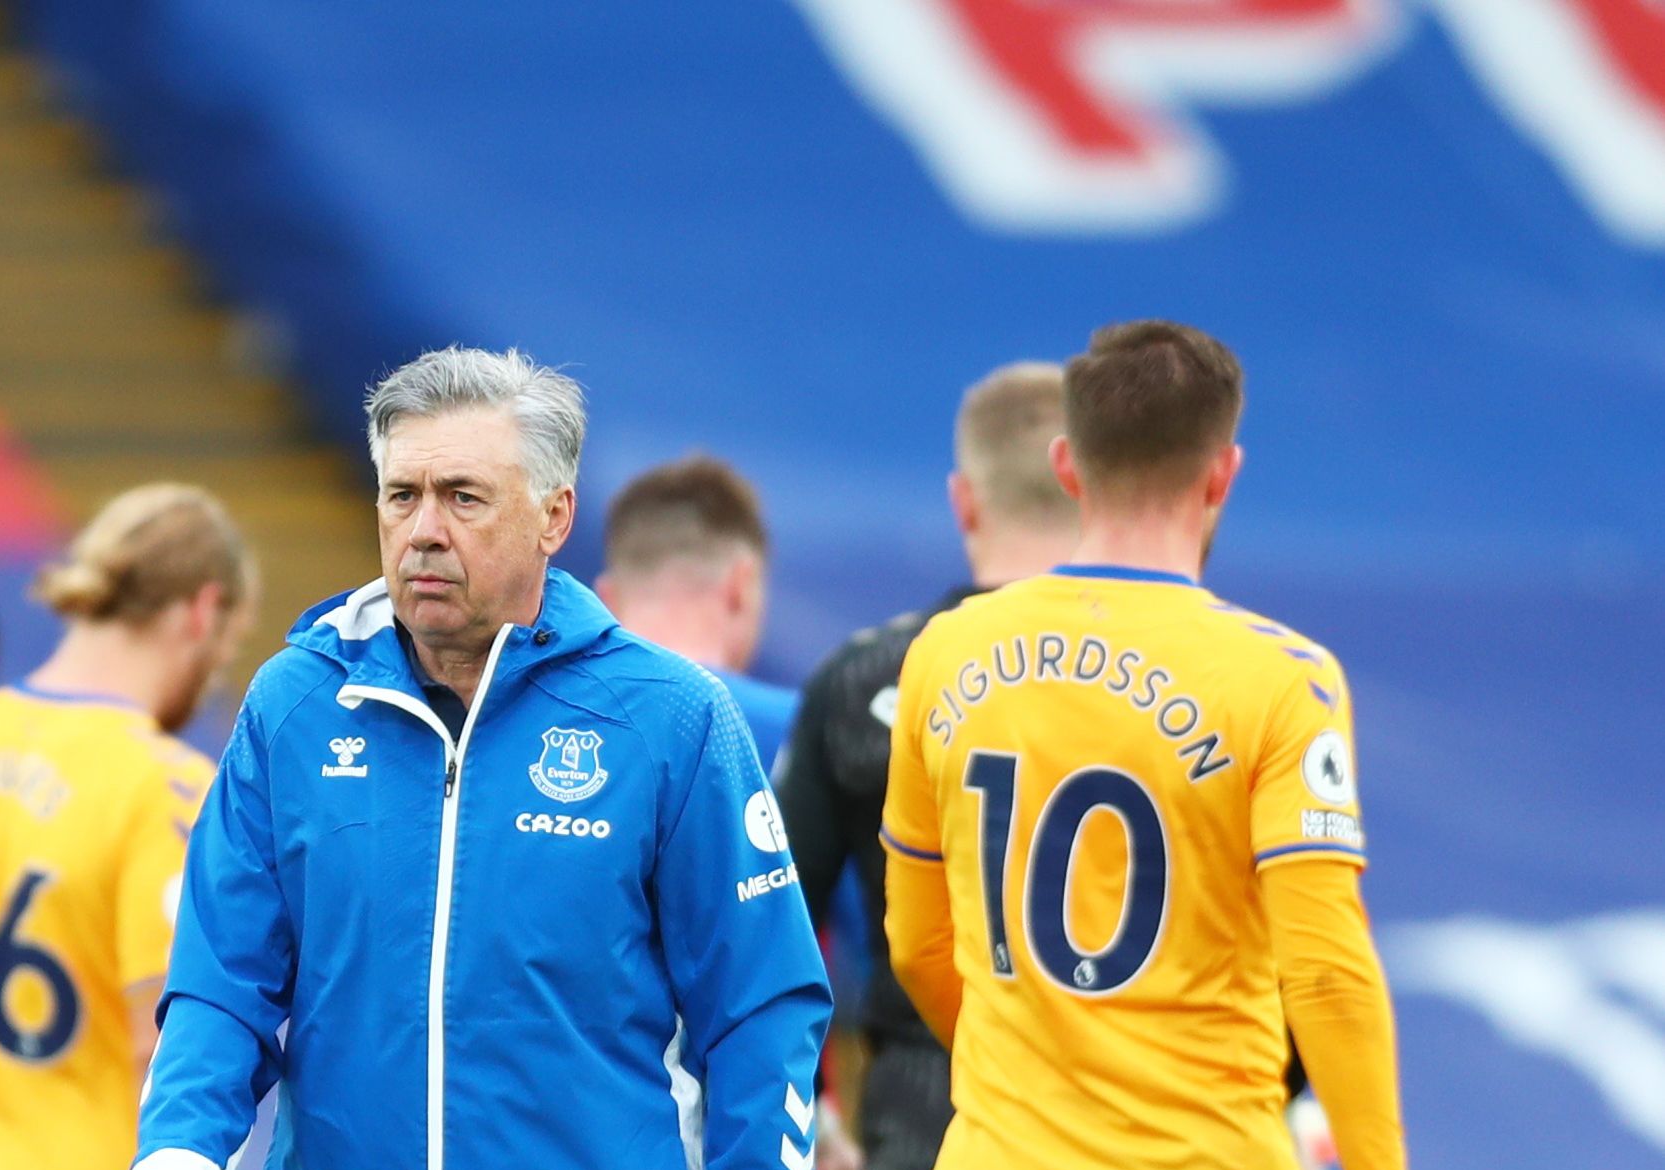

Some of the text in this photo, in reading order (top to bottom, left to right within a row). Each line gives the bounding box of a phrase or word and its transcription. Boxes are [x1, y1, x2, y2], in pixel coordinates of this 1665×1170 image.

[928, 634, 1232, 783] SIGURDSSON
[547, 767, 590, 781] Everton
[515, 812, 611, 839] CAZOO
[963, 748, 1167, 998] 10
